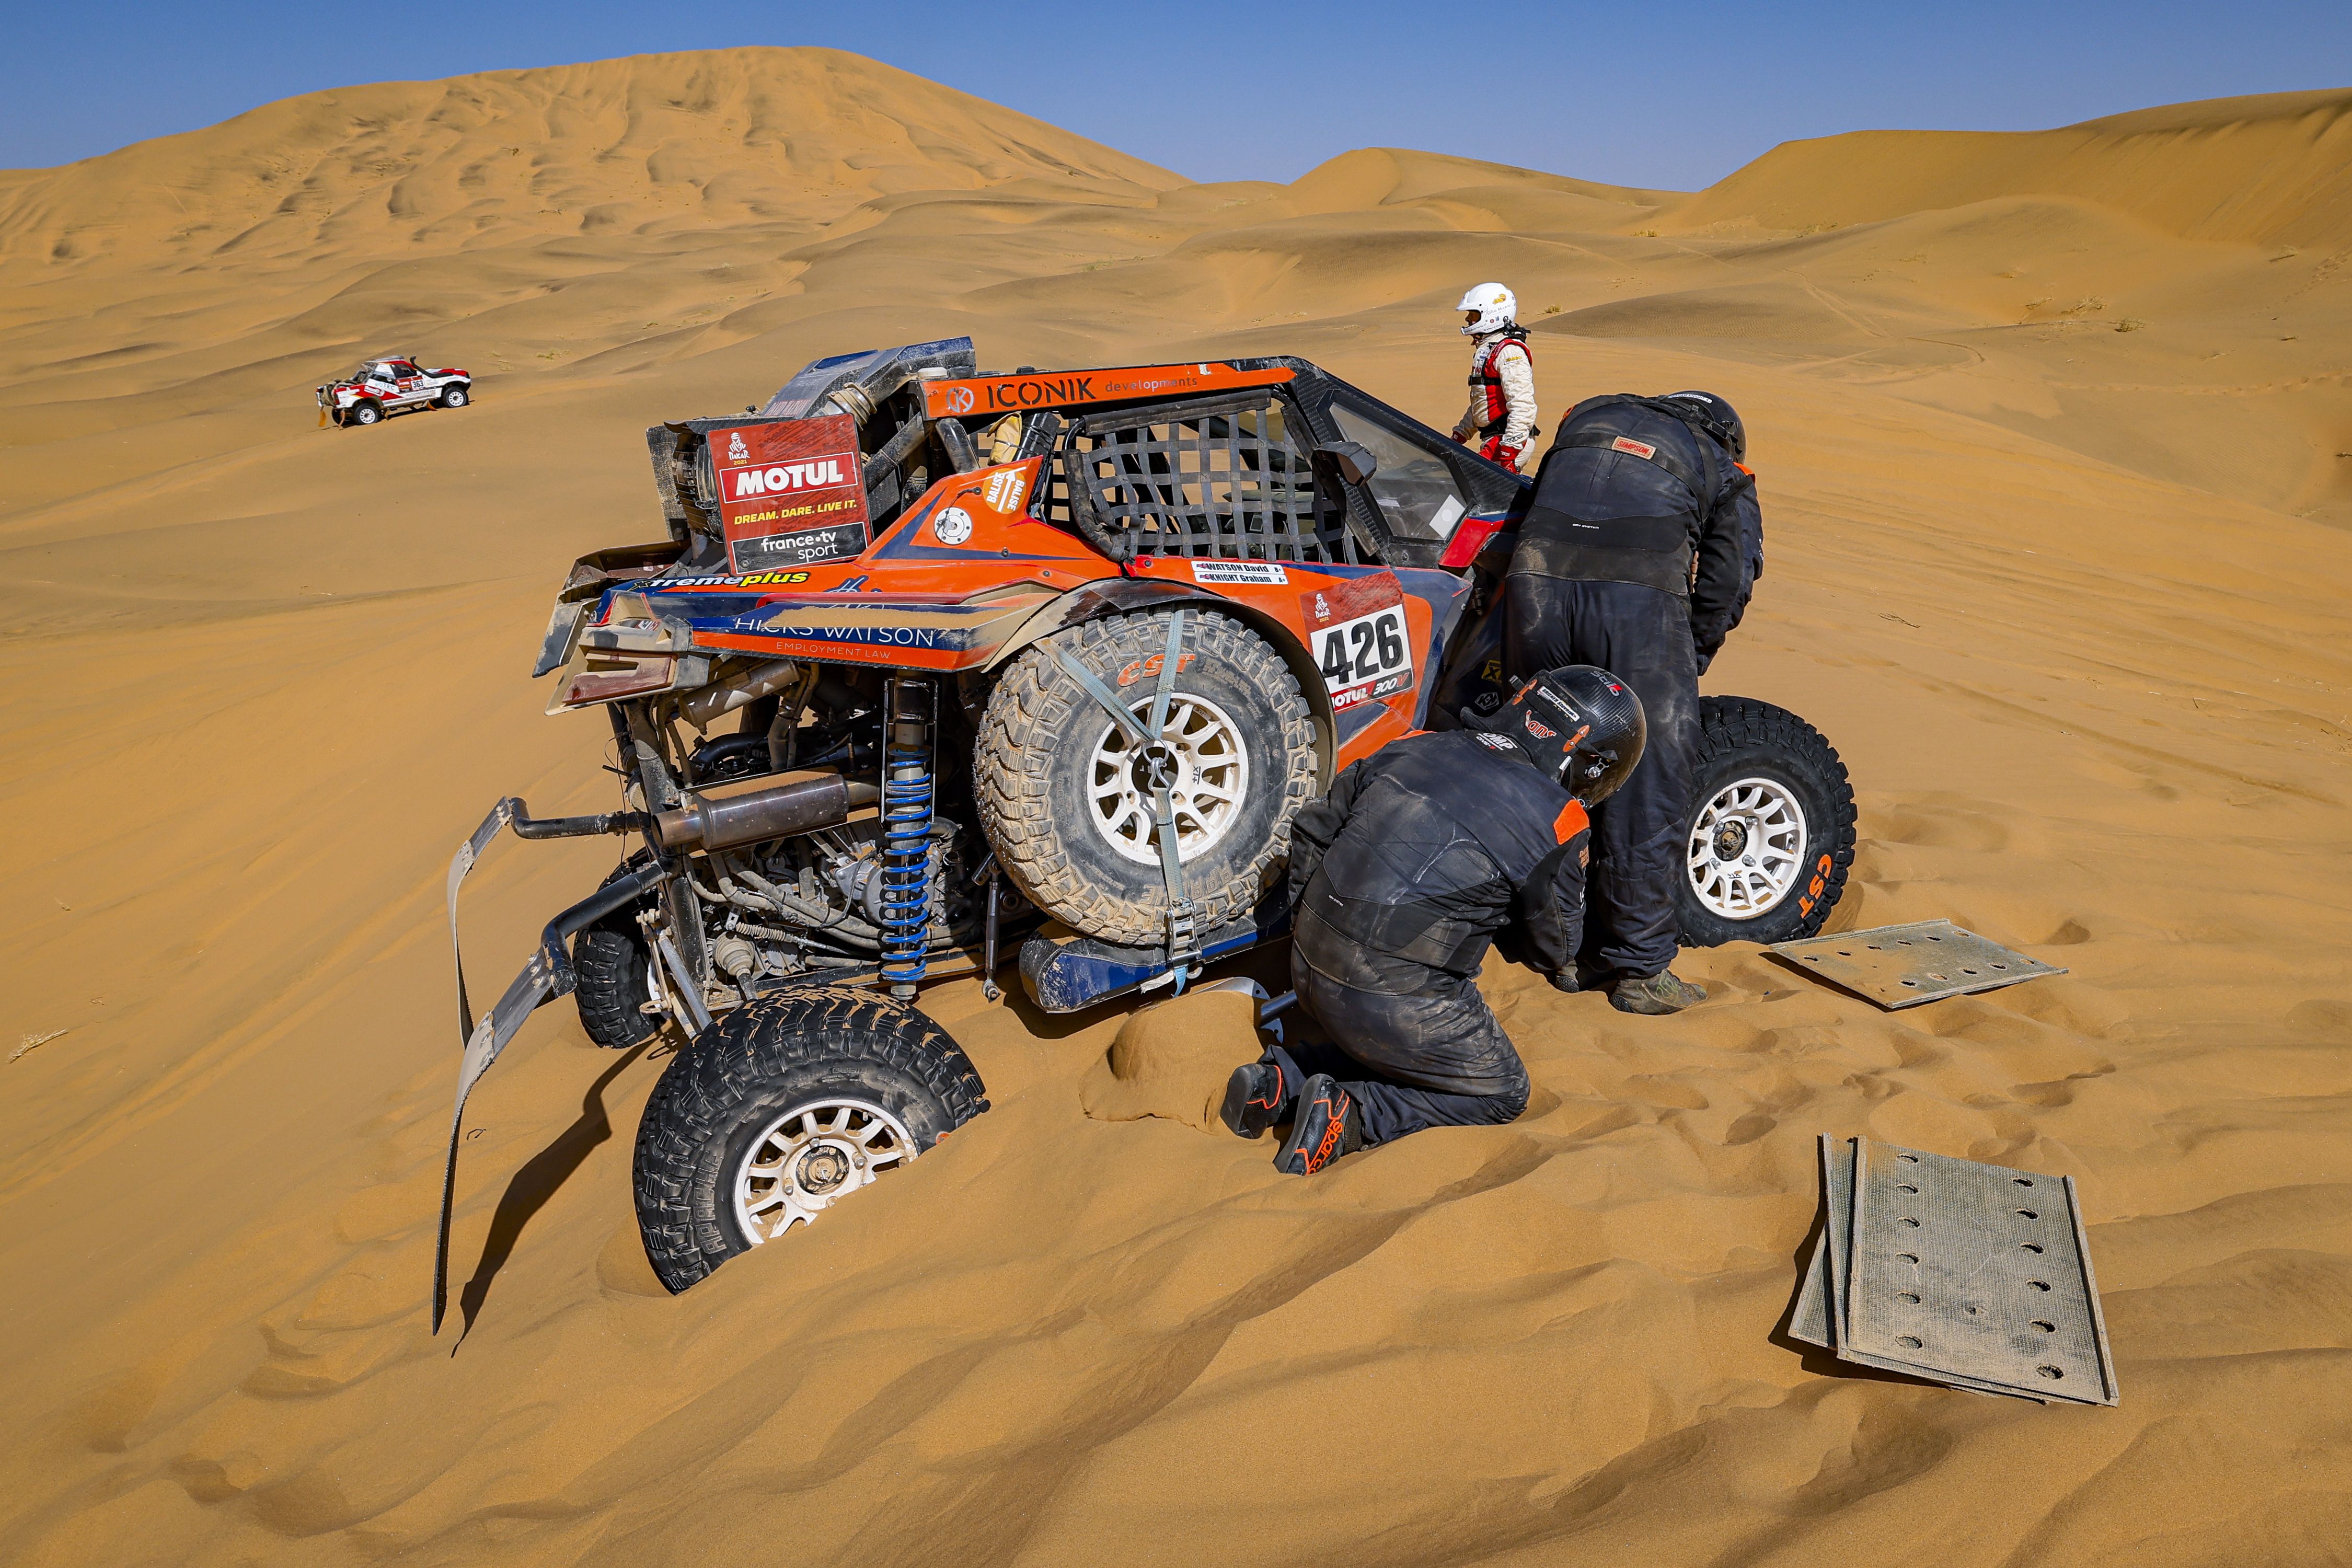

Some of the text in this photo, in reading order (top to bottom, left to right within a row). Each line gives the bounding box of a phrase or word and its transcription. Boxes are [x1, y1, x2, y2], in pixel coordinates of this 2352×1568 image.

[412, 380, 424, 388] 363
[987, 376, 1197, 408] ICONIK developments
[728, 451, 750, 460] DAKAR
[1617, 441, 1650, 455] SIMPSON
[735, 460, 844, 496] MOTUL
[986, 472, 1005, 504] BALISE
[1007, 479, 1025, 511] BALISE
[734, 499, 857, 525] DREAM. DARE. LIVE IT.
[798, 543, 838, 562] sport
[1207, 563, 1243, 571] WATSON
[1241, 574, 1272, 583] Graham
[1315, 608, 1332, 619] DAKAR
[776, 641, 892, 659] EMPLOYMENT LAW
[1322, 613, 1404, 685] 426
[1117, 653, 1196, 687] CST
[1373, 672, 1410, 695] 300V
[1482, 732, 1514, 750] OMP
[1797, 854, 1832, 919] CST
[1308, 1121, 1344, 1175] sparco
[693, 1150, 728, 1254] APACHE
